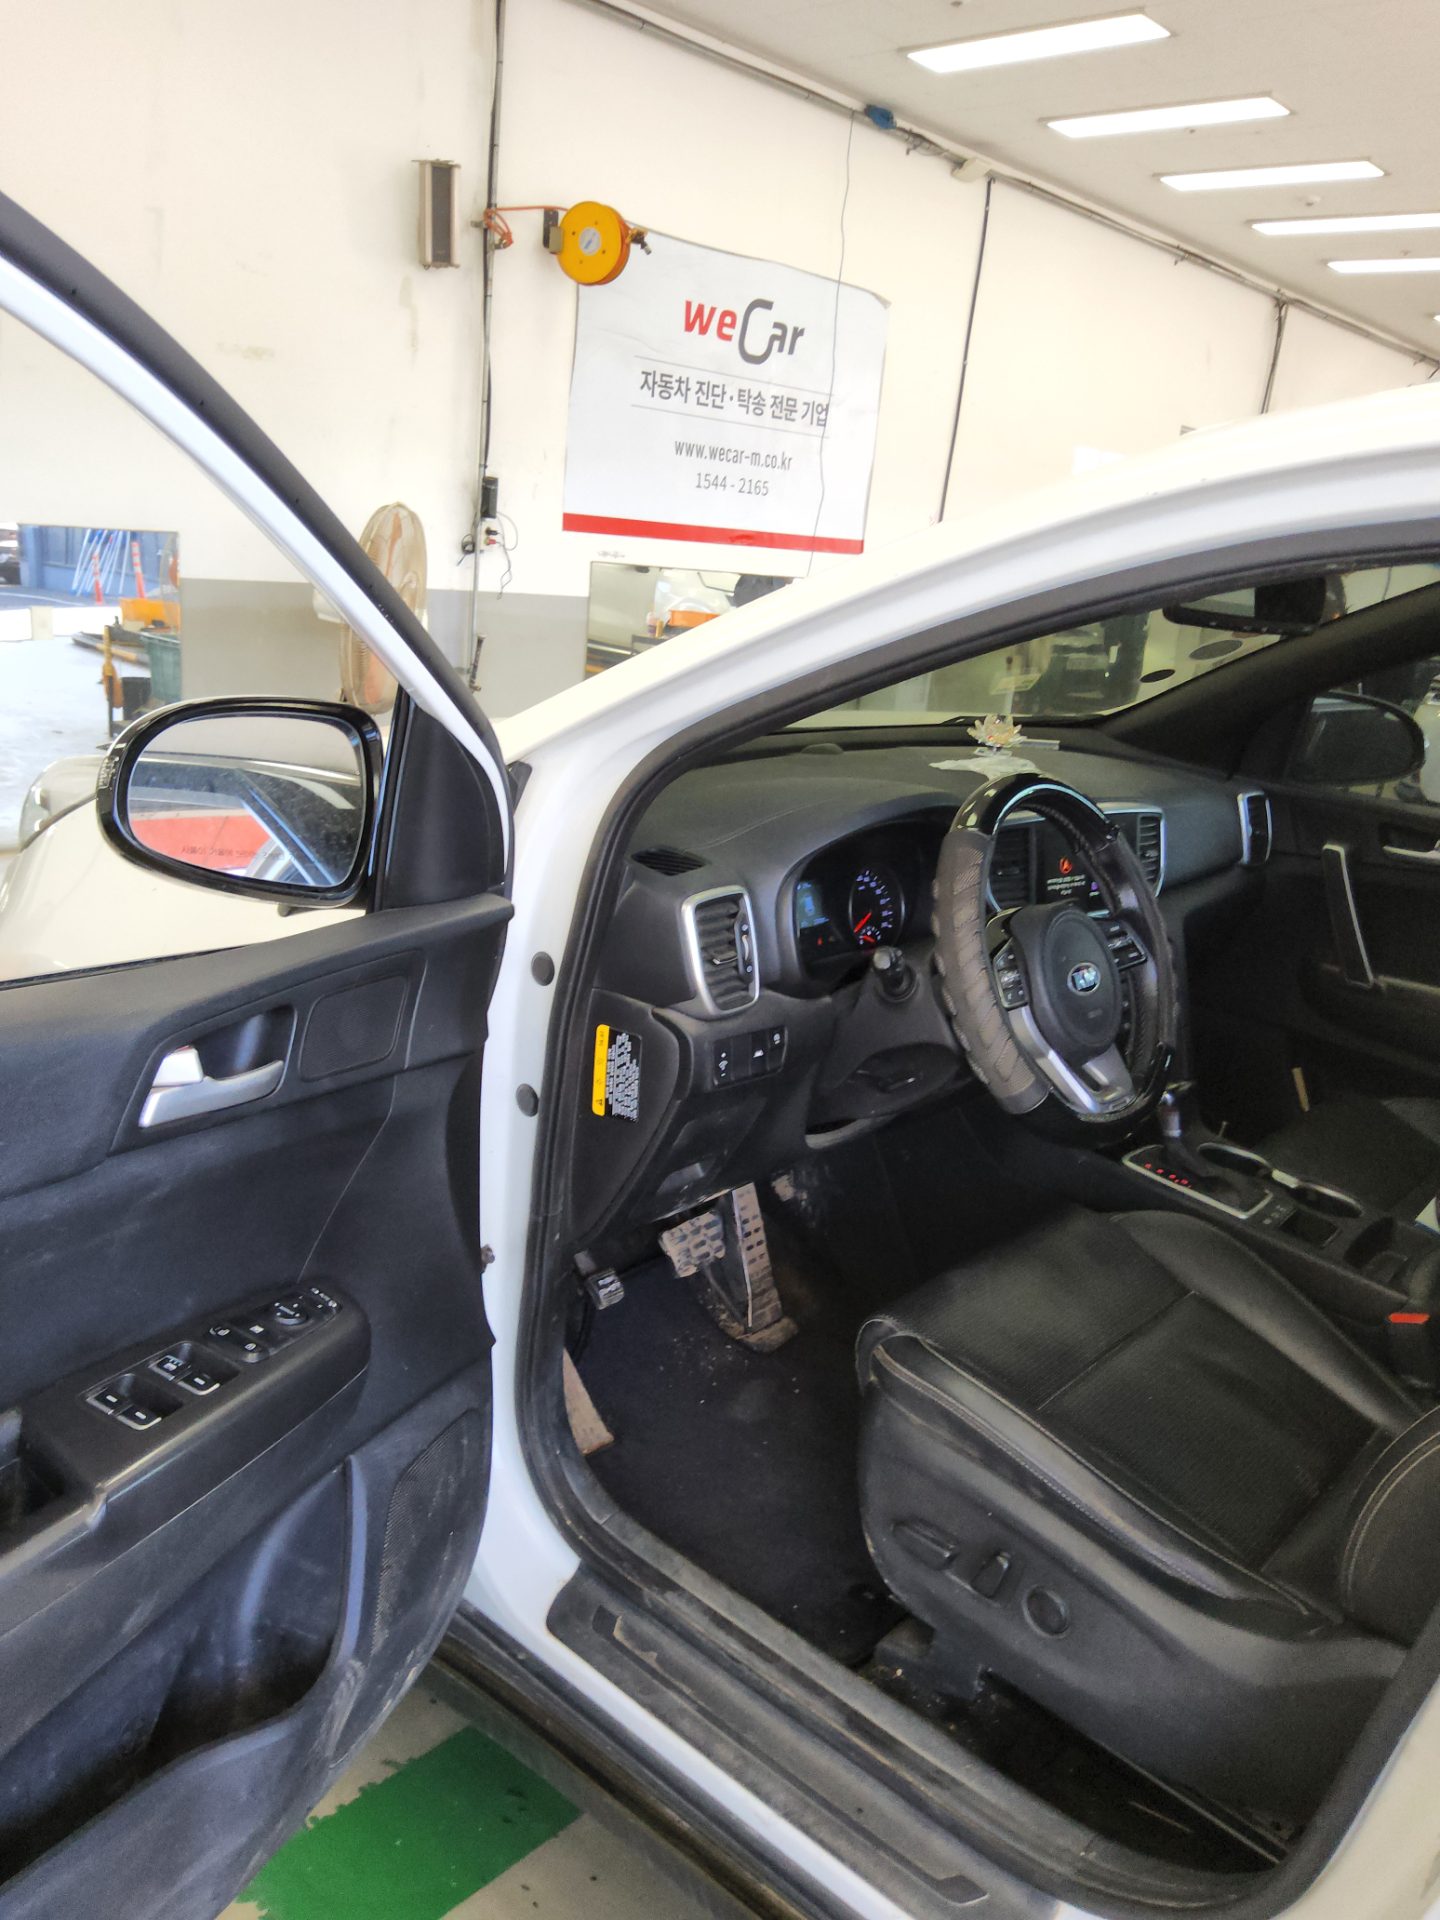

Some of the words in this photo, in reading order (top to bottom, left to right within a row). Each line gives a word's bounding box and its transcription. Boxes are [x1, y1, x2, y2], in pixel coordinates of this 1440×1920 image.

[640, 370, 692, 404] 자동차
[770, 395, 798, 422] 전문
[801, 400, 830, 427] 기업
[674, 440, 793, 471] www.wecar-m.co.kr
